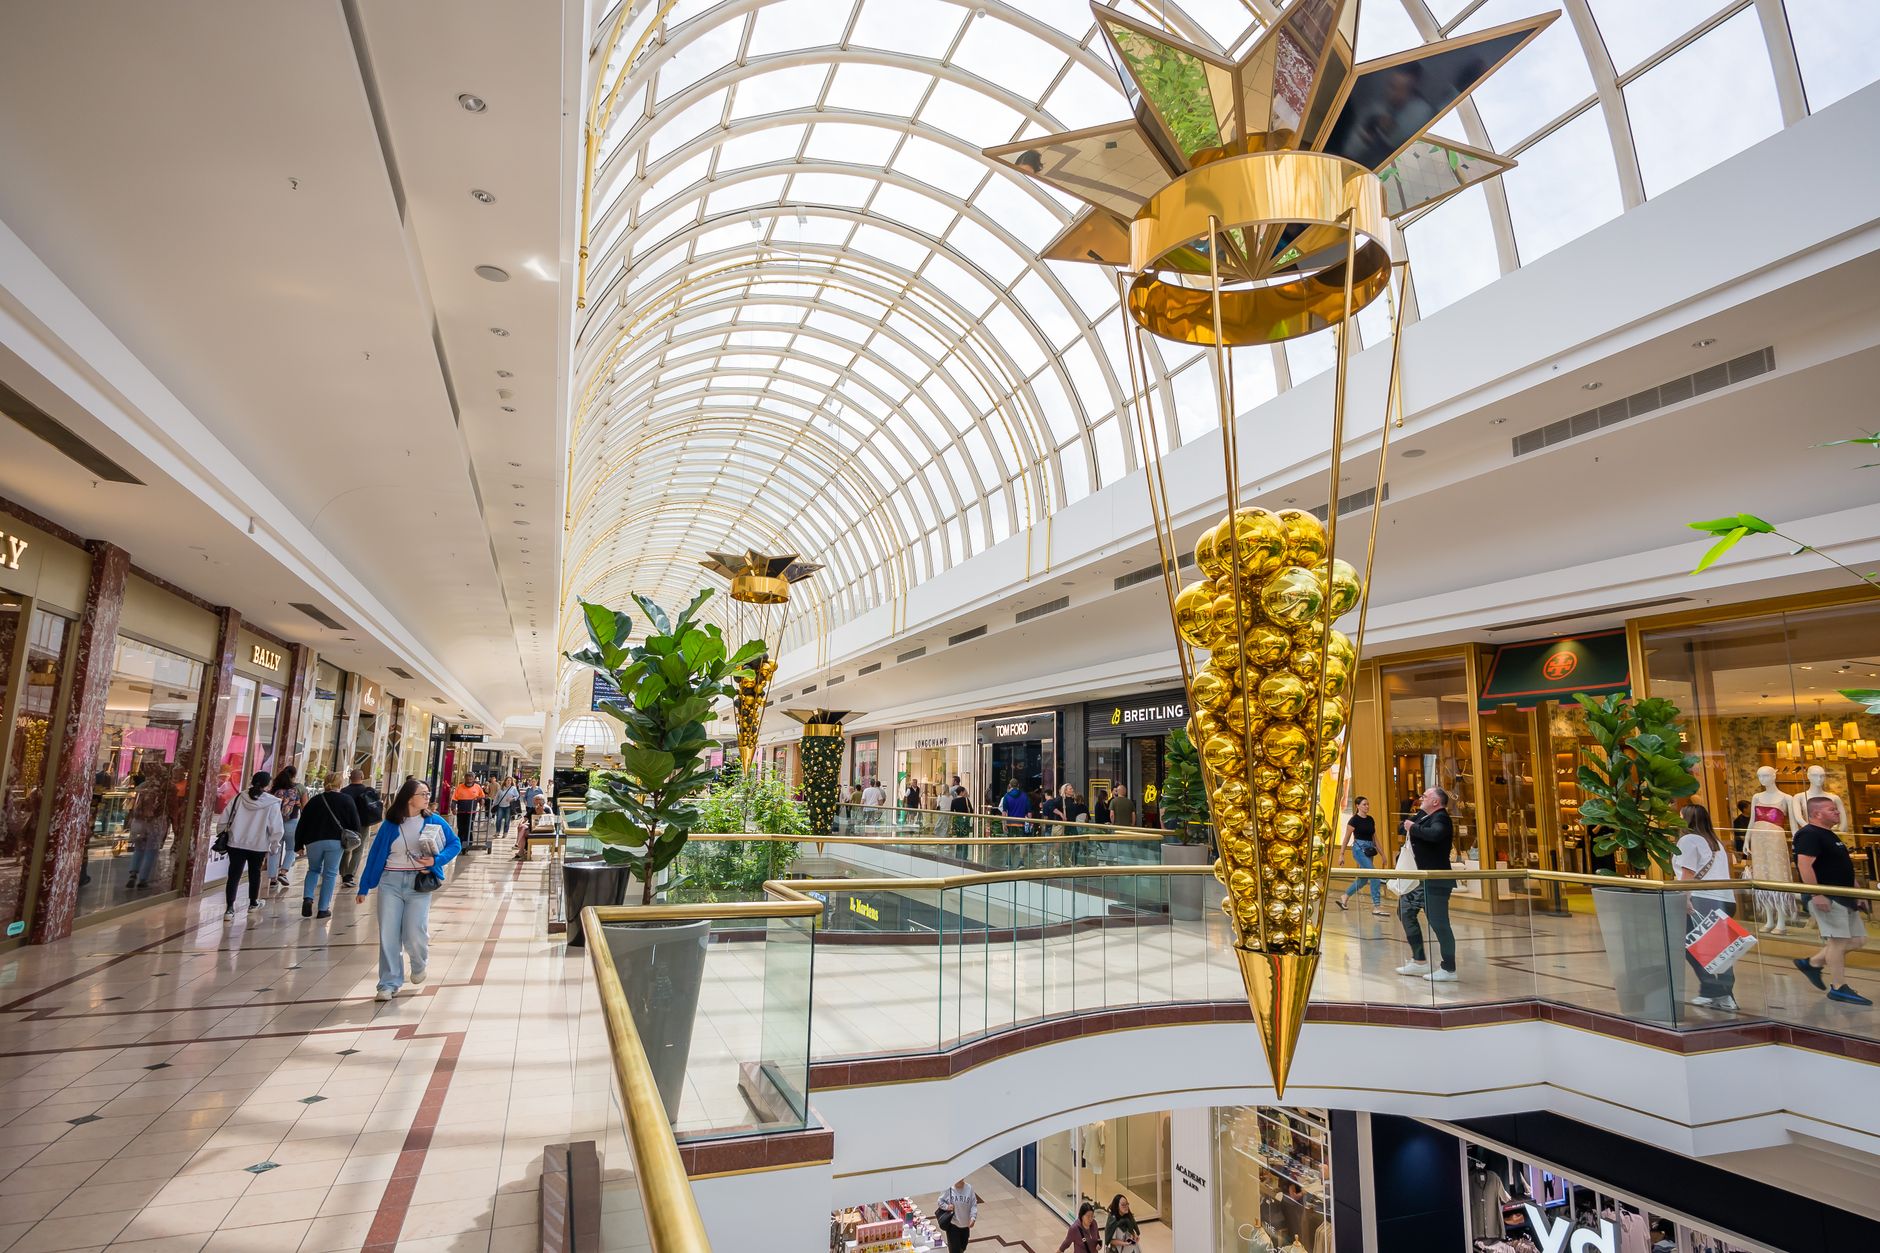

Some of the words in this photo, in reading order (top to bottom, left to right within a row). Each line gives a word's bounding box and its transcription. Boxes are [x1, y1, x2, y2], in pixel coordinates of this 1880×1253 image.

[253, 645, 282, 671] BALLY
[1124, 704, 1184, 723] BREITLING
[995, 725, 1010, 737] TOM
[1010, 722, 1029, 736] FORD
[915, 737, 948, 749] LONGCHAMP
[856, 899, 879, 921] Martens
[1685, 911, 1719, 945] MYER
[1706, 963, 1718, 972] MY
[1720, 936, 1745, 961] STORE
[1175, 1163, 1206, 1188] ACADEMY
[1182, 1178, 1199, 1191] BRAND
[951, 1195, 971, 1203] PARIS
